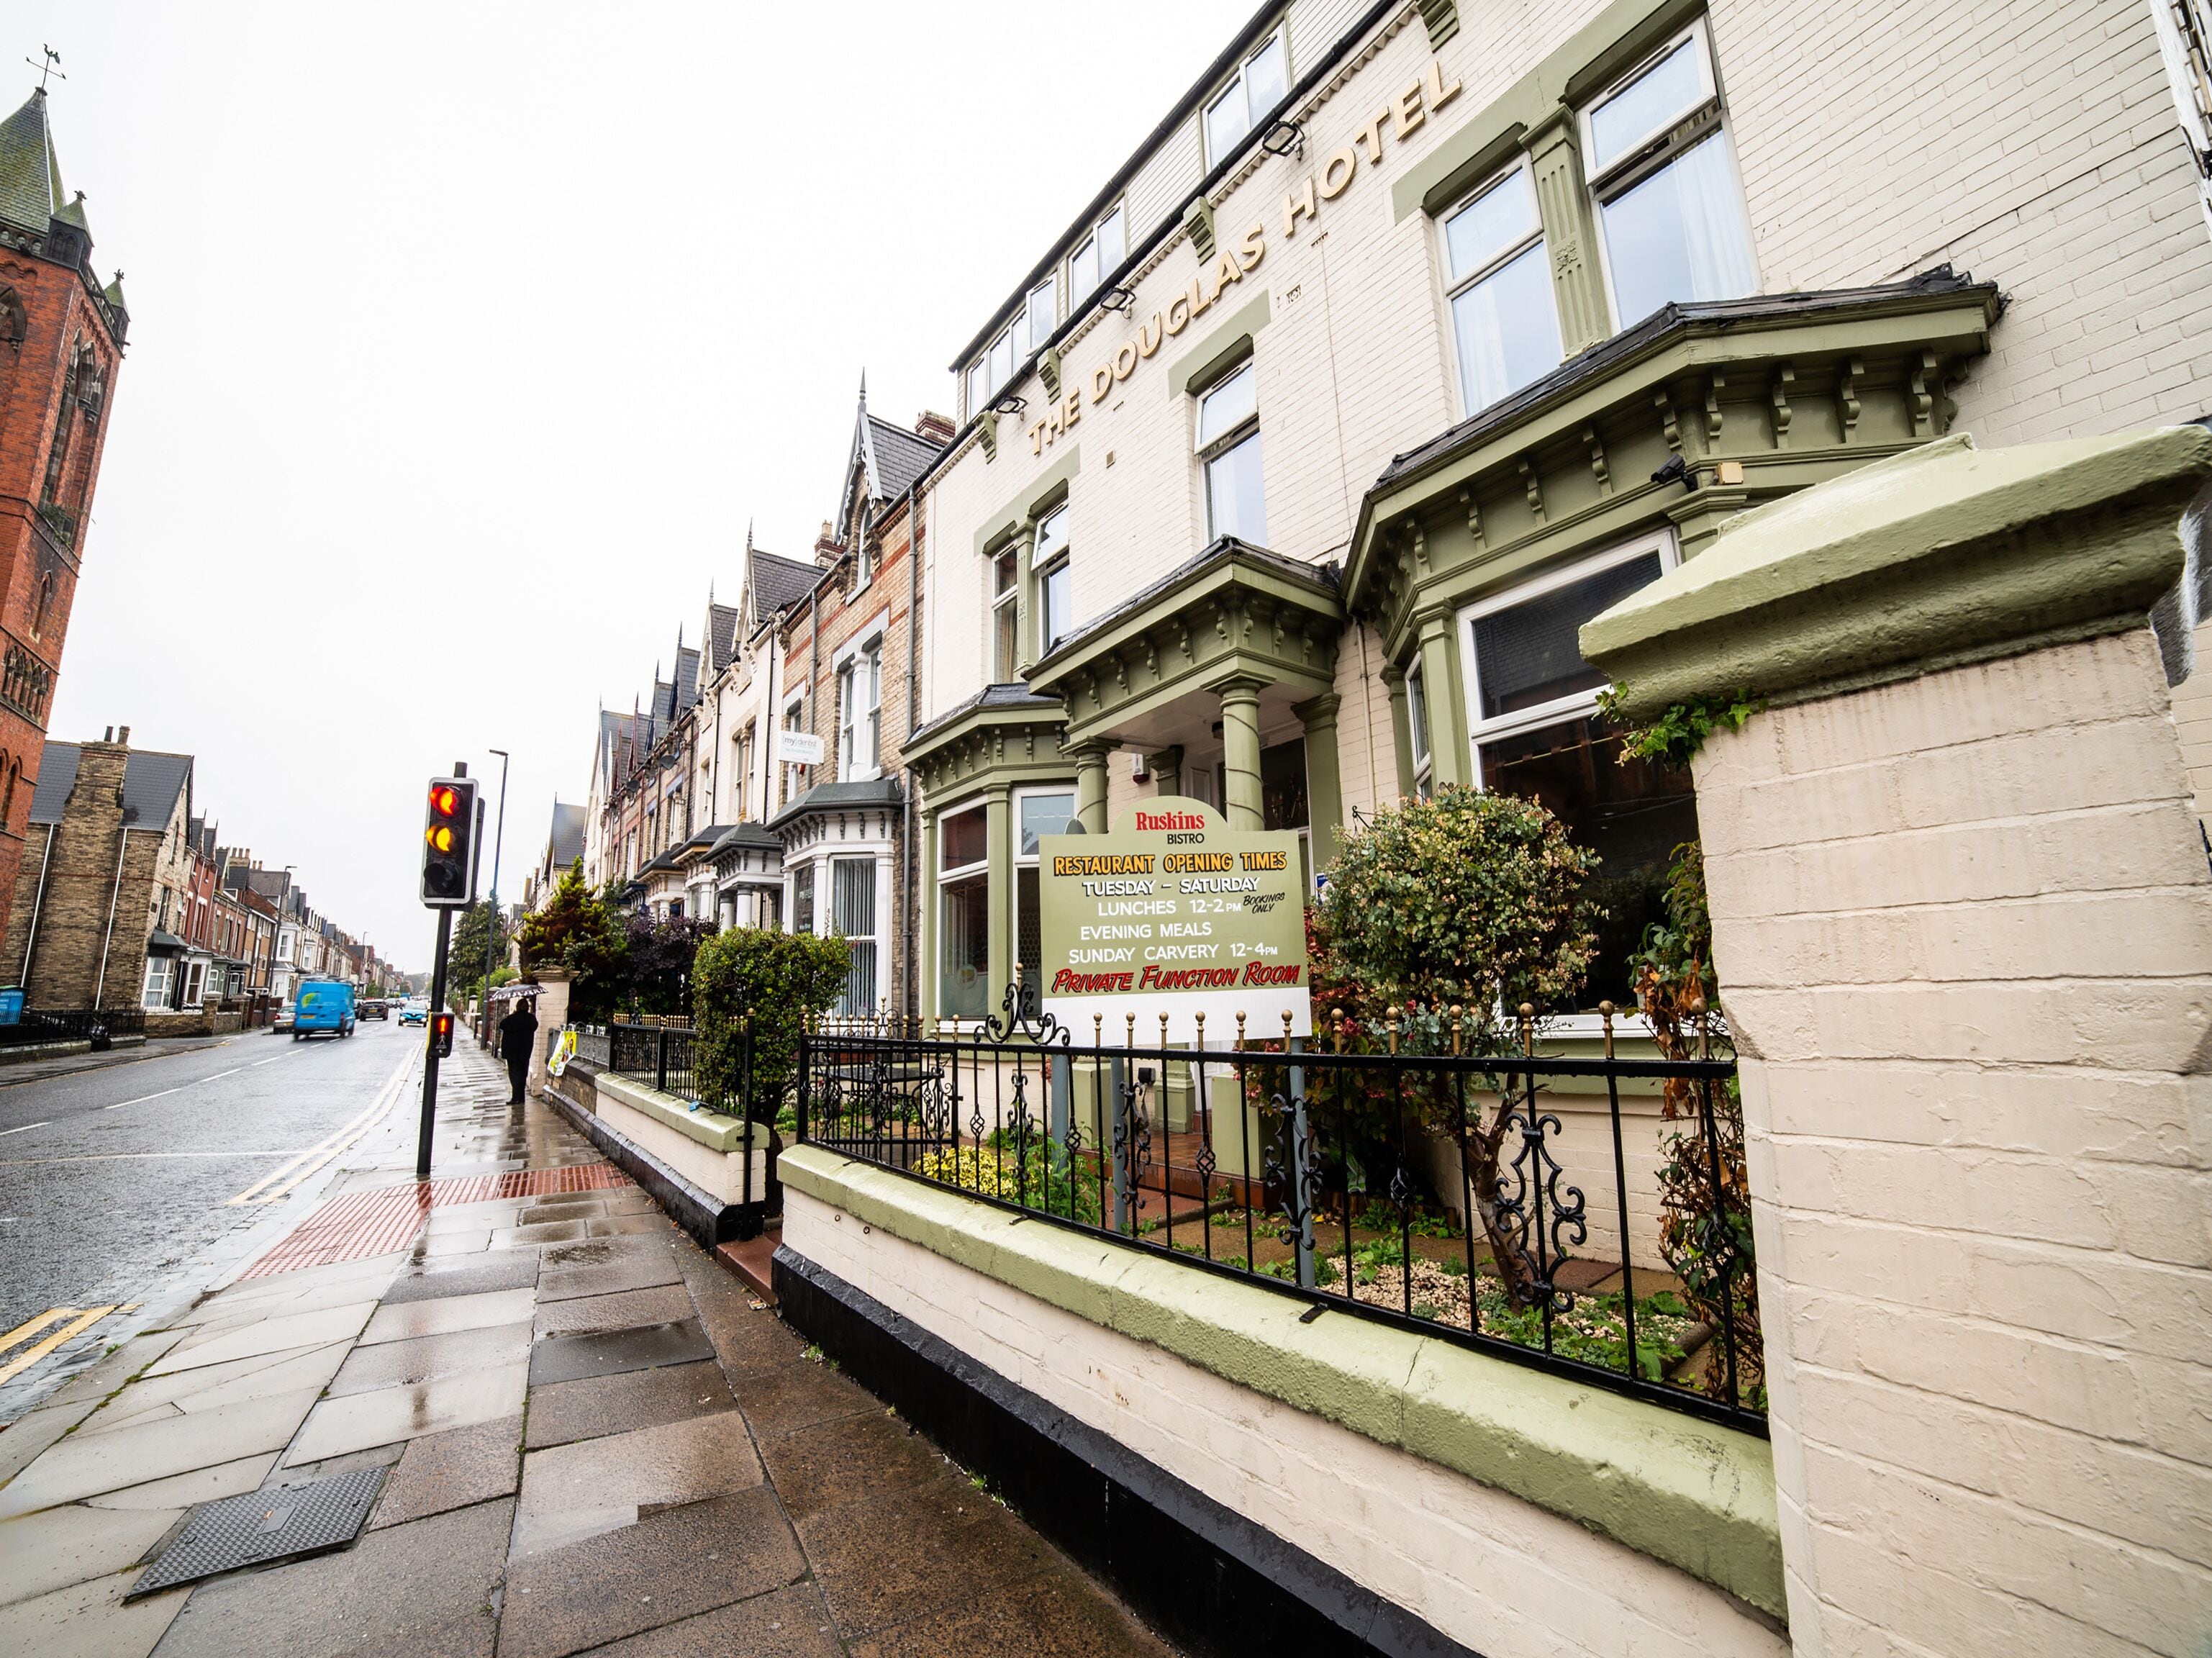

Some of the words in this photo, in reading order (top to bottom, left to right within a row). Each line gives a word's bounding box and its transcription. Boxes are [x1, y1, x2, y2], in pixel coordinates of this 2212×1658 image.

[1029, 387, 1080, 456] THE
[1091, 225, 1266, 405] DOUGLAS
[1282, 61, 1461, 238] HOTEL
[1136, 811, 1205, 830] Ruskins
[1167, 834, 1205, 845] BISTRO
[1054, 855, 1155, 876] RESTAURANT
[1164, 853, 1233, 873] OPENING
[1241, 851, 1287, 871] TIMES
[1082, 879, 1156, 897] TUESDAY
[1180, 877, 1260, 894] SATURDAY
[1098, 900, 1177, 916] LUNCHES
[1243, 892, 1284, 906] BOOKINGS
[1252, 904, 1274, 914] ONLY
[1081, 925, 1151, 940] EVENING
[1160, 922, 1212, 937] MEALS
[1069, 947, 1136, 964] SUNDAY
[1144, 944, 1219, 960] CARVERY
[1052, 969, 1134, 993] PRIVATE
[1139, 965, 1239, 989] FUNCTION
[1243, 961, 1300, 986] ROOM
